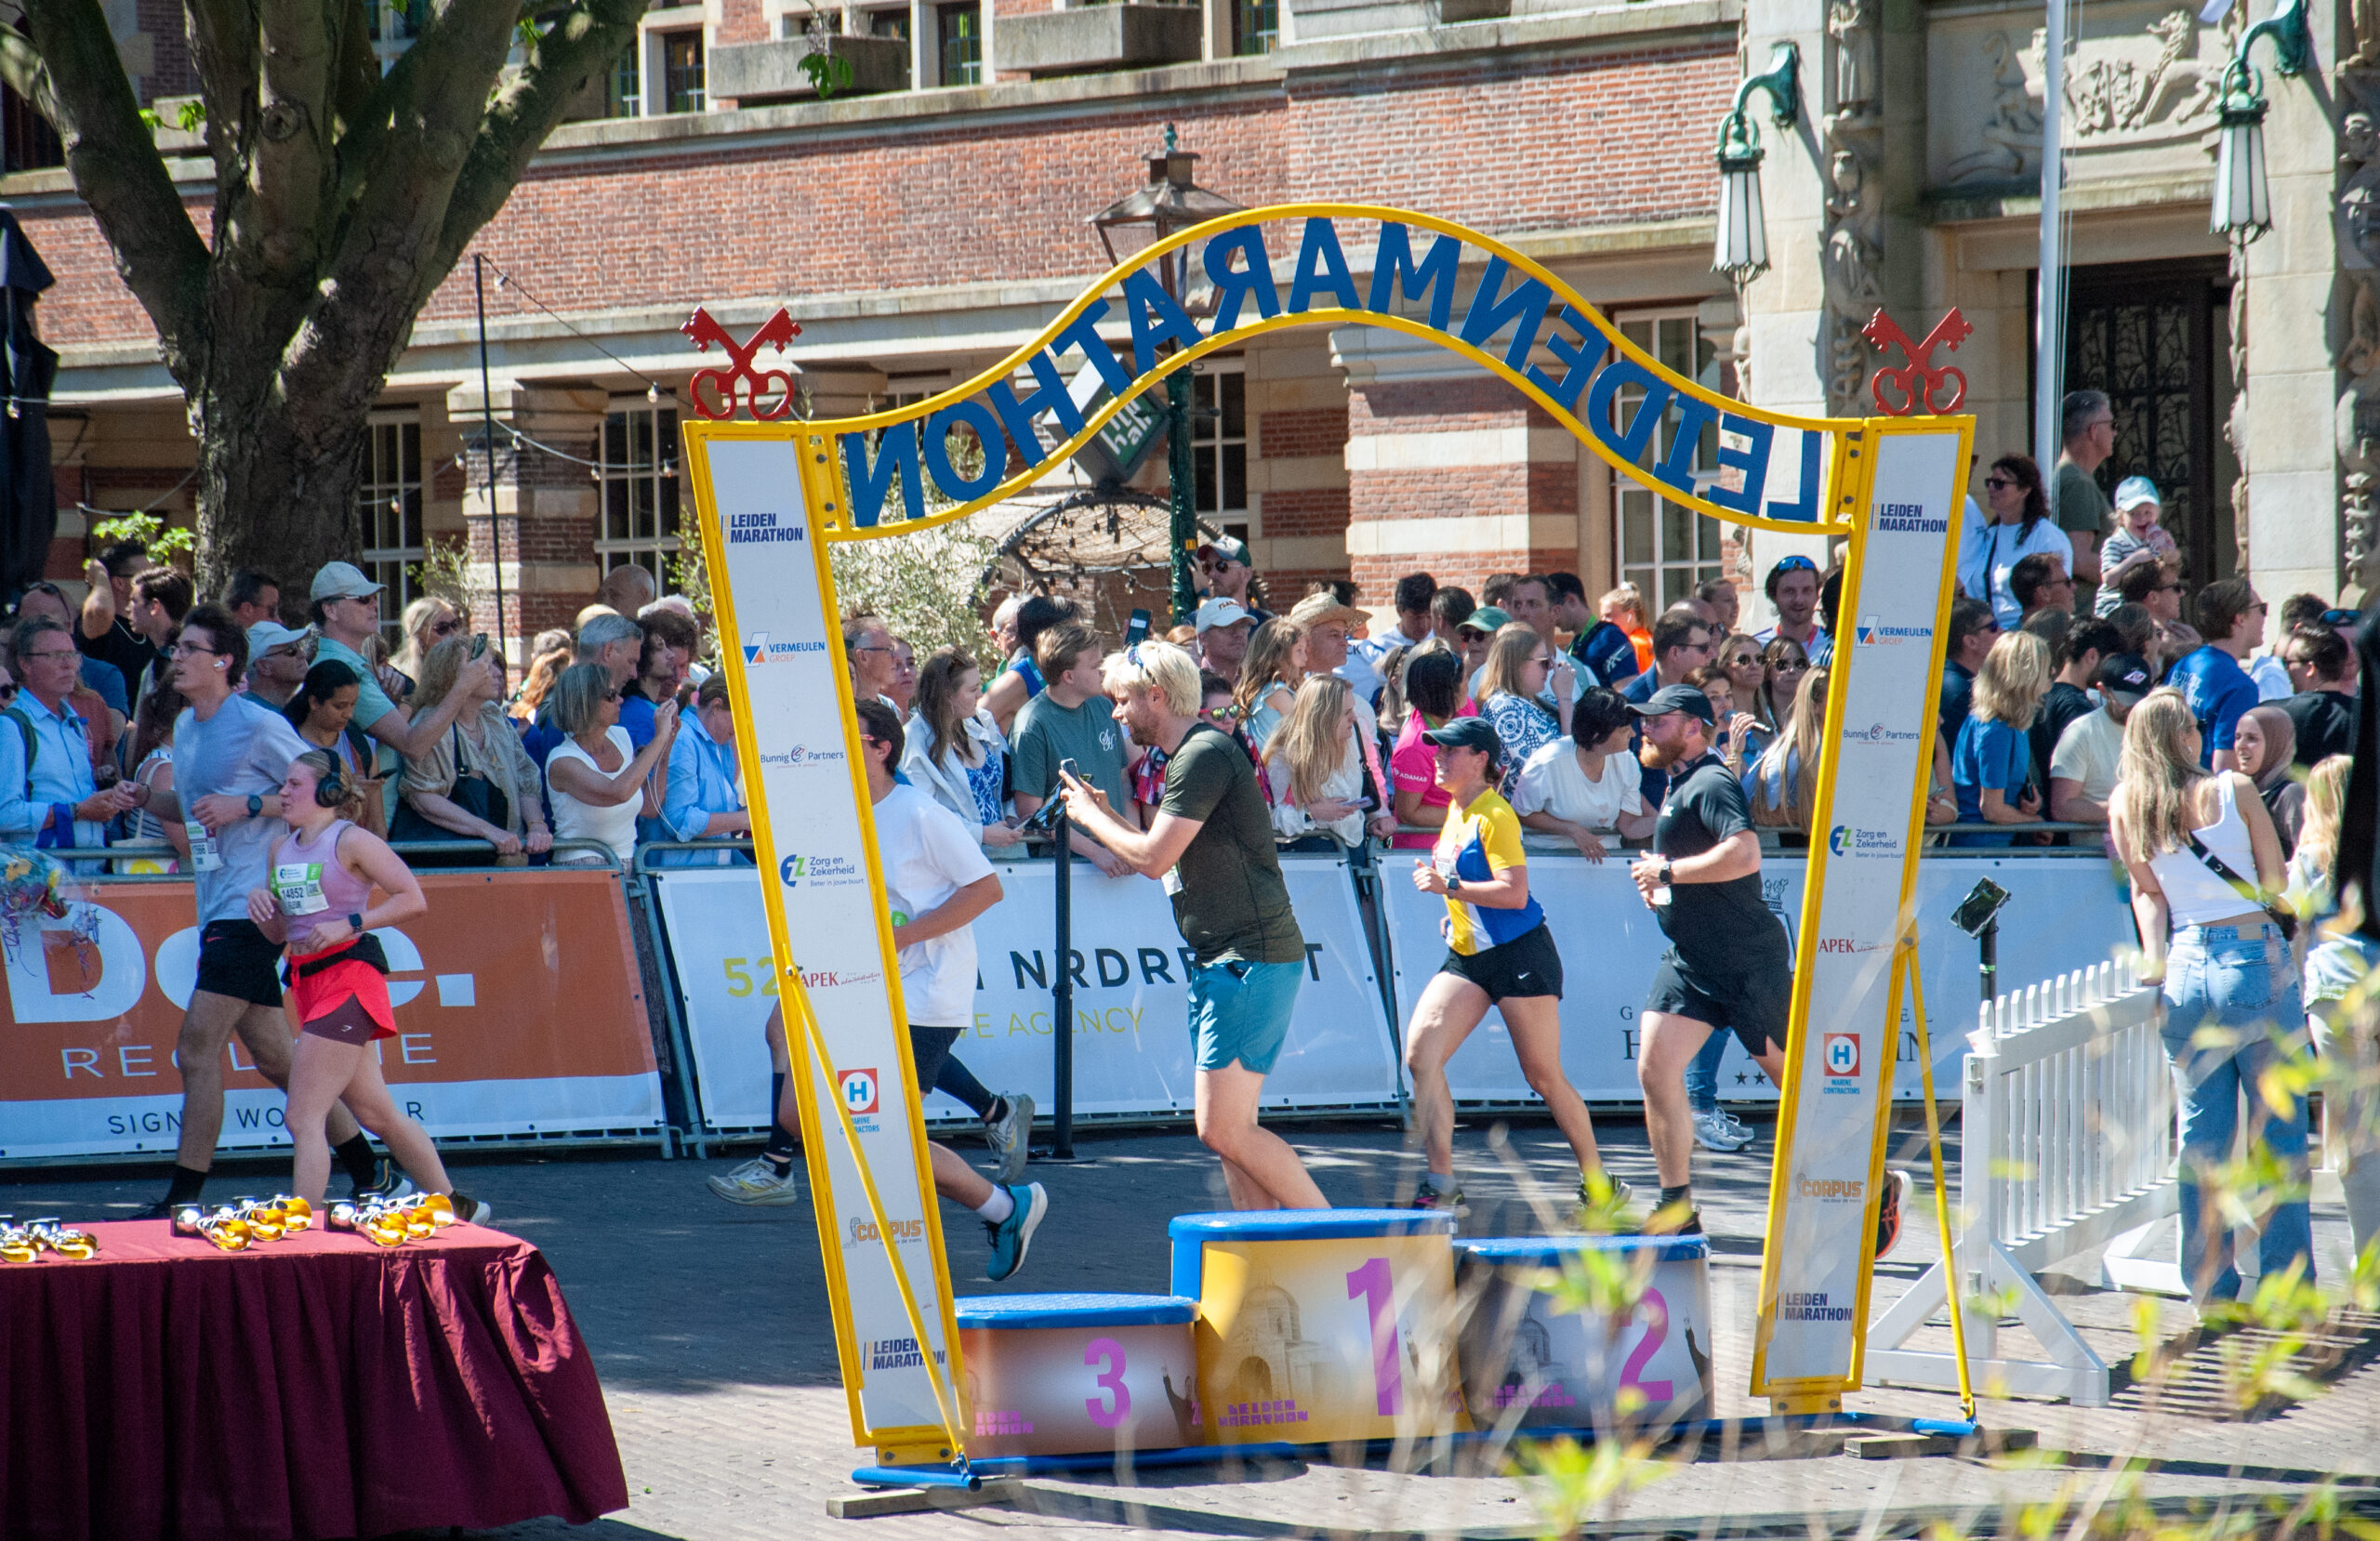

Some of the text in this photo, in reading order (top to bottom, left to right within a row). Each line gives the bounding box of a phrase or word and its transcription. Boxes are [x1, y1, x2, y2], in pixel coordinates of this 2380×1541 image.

[1880, 504, 1923, 518] LEIDEN
[731, 513, 776, 528] LEIDEN
[1879, 518, 1947, 533] MARATHON
[730, 527, 803, 543] MARATHON
[1879, 626, 1932, 637] VERMEULEN
[768, 641, 826, 653] VERMEULEN
[1879, 637, 1903, 645] GROEP
[769, 653, 795, 663] GROEP
[1886, 731, 1920, 740] Partners
[760, 751, 844, 763] Bunnig Partners
[1399, 771, 1428, 783] ADAMAS
[1857, 829, 1874, 840] Zorg
[1856, 838, 1897, 848] Zekerheid
[810, 856, 830, 867] Zorg
[810, 864, 855, 876] Zekerheid
[281, 888, 305, 901] 14852
[1818, 938, 1855, 953] APEK
[801, 971, 840, 988] APEK
[1008, 1007, 1144, 1036] AGNCY
[852, 1116, 870, 1125] ARINE
[1802, 1180, 1862, 1197] CORPUS
[856, 1219, 921, 1242] COPUS
[1786, 1293, 1828, 1306] LEIDEN
[1785, 1307, 1853, 1321] MARATHON
[1346, 1258, 1405, 1416] 1
[874, 1338, 919, 1354] LEIDEN
[1618, 1286, 1673, 1403] 2
[873, 1350, 945, 1370] MARATHN
[1084, 1337, 1131, 1429] 3
[1228, 1399, 1296, 1415] LEIDEN
[975, 1411, 1021, 1423] IDEN
